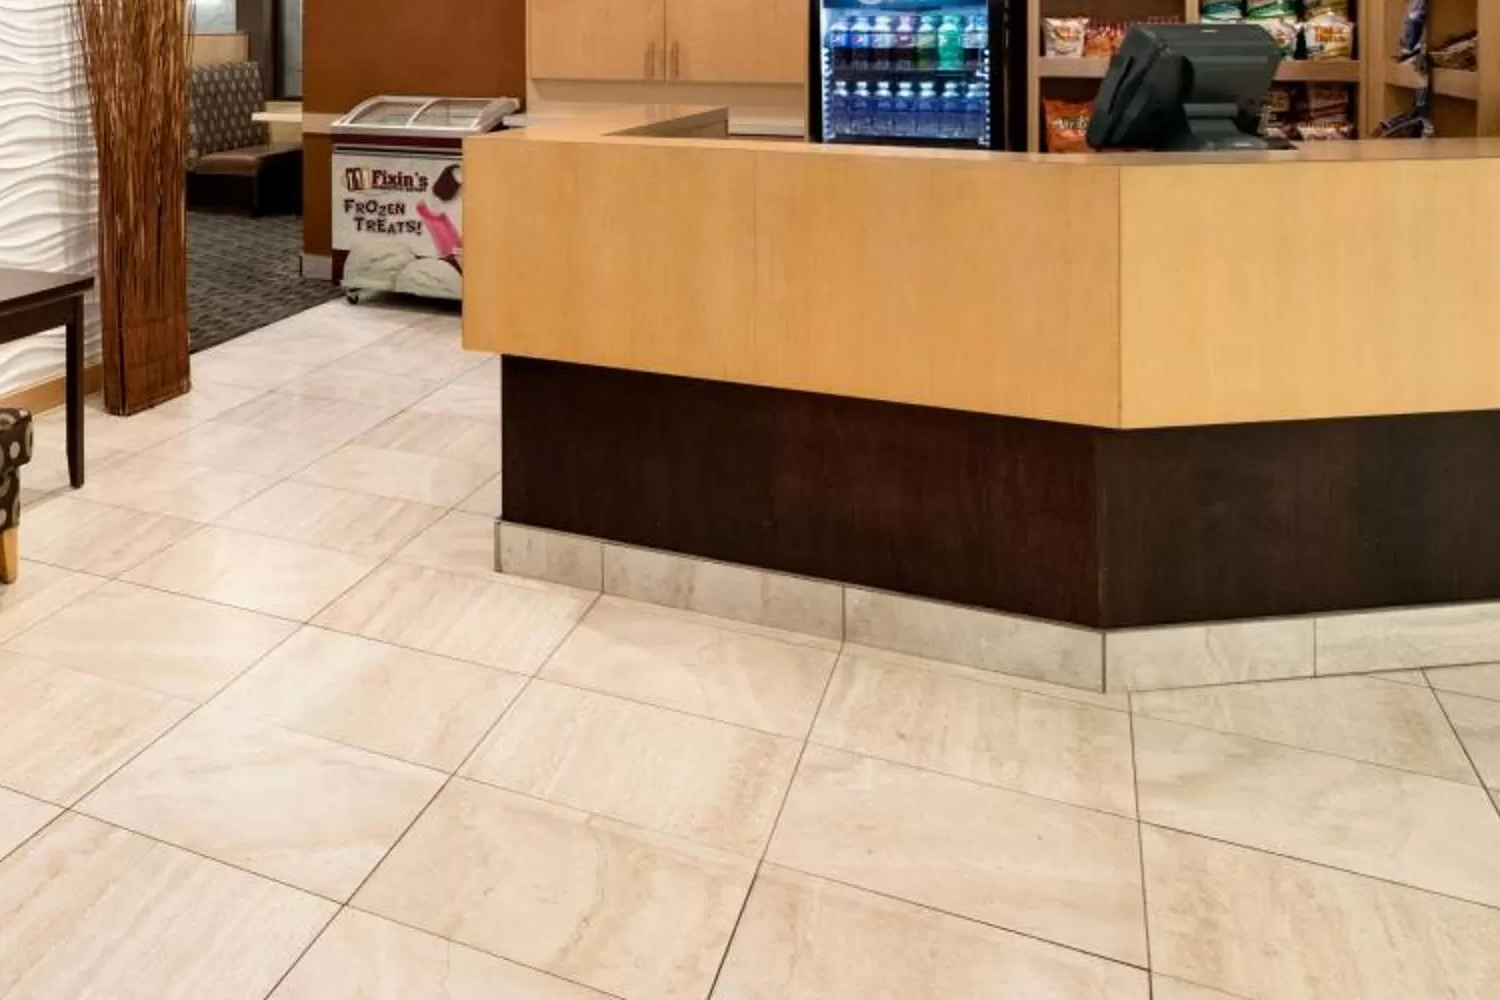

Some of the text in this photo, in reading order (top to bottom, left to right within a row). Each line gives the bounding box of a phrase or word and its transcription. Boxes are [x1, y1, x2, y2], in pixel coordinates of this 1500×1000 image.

[371, 169, 429, 187] Fixin's
[343, 198, 405, 216] FROZEN
[353, 217, 422, 236] TREATS!
